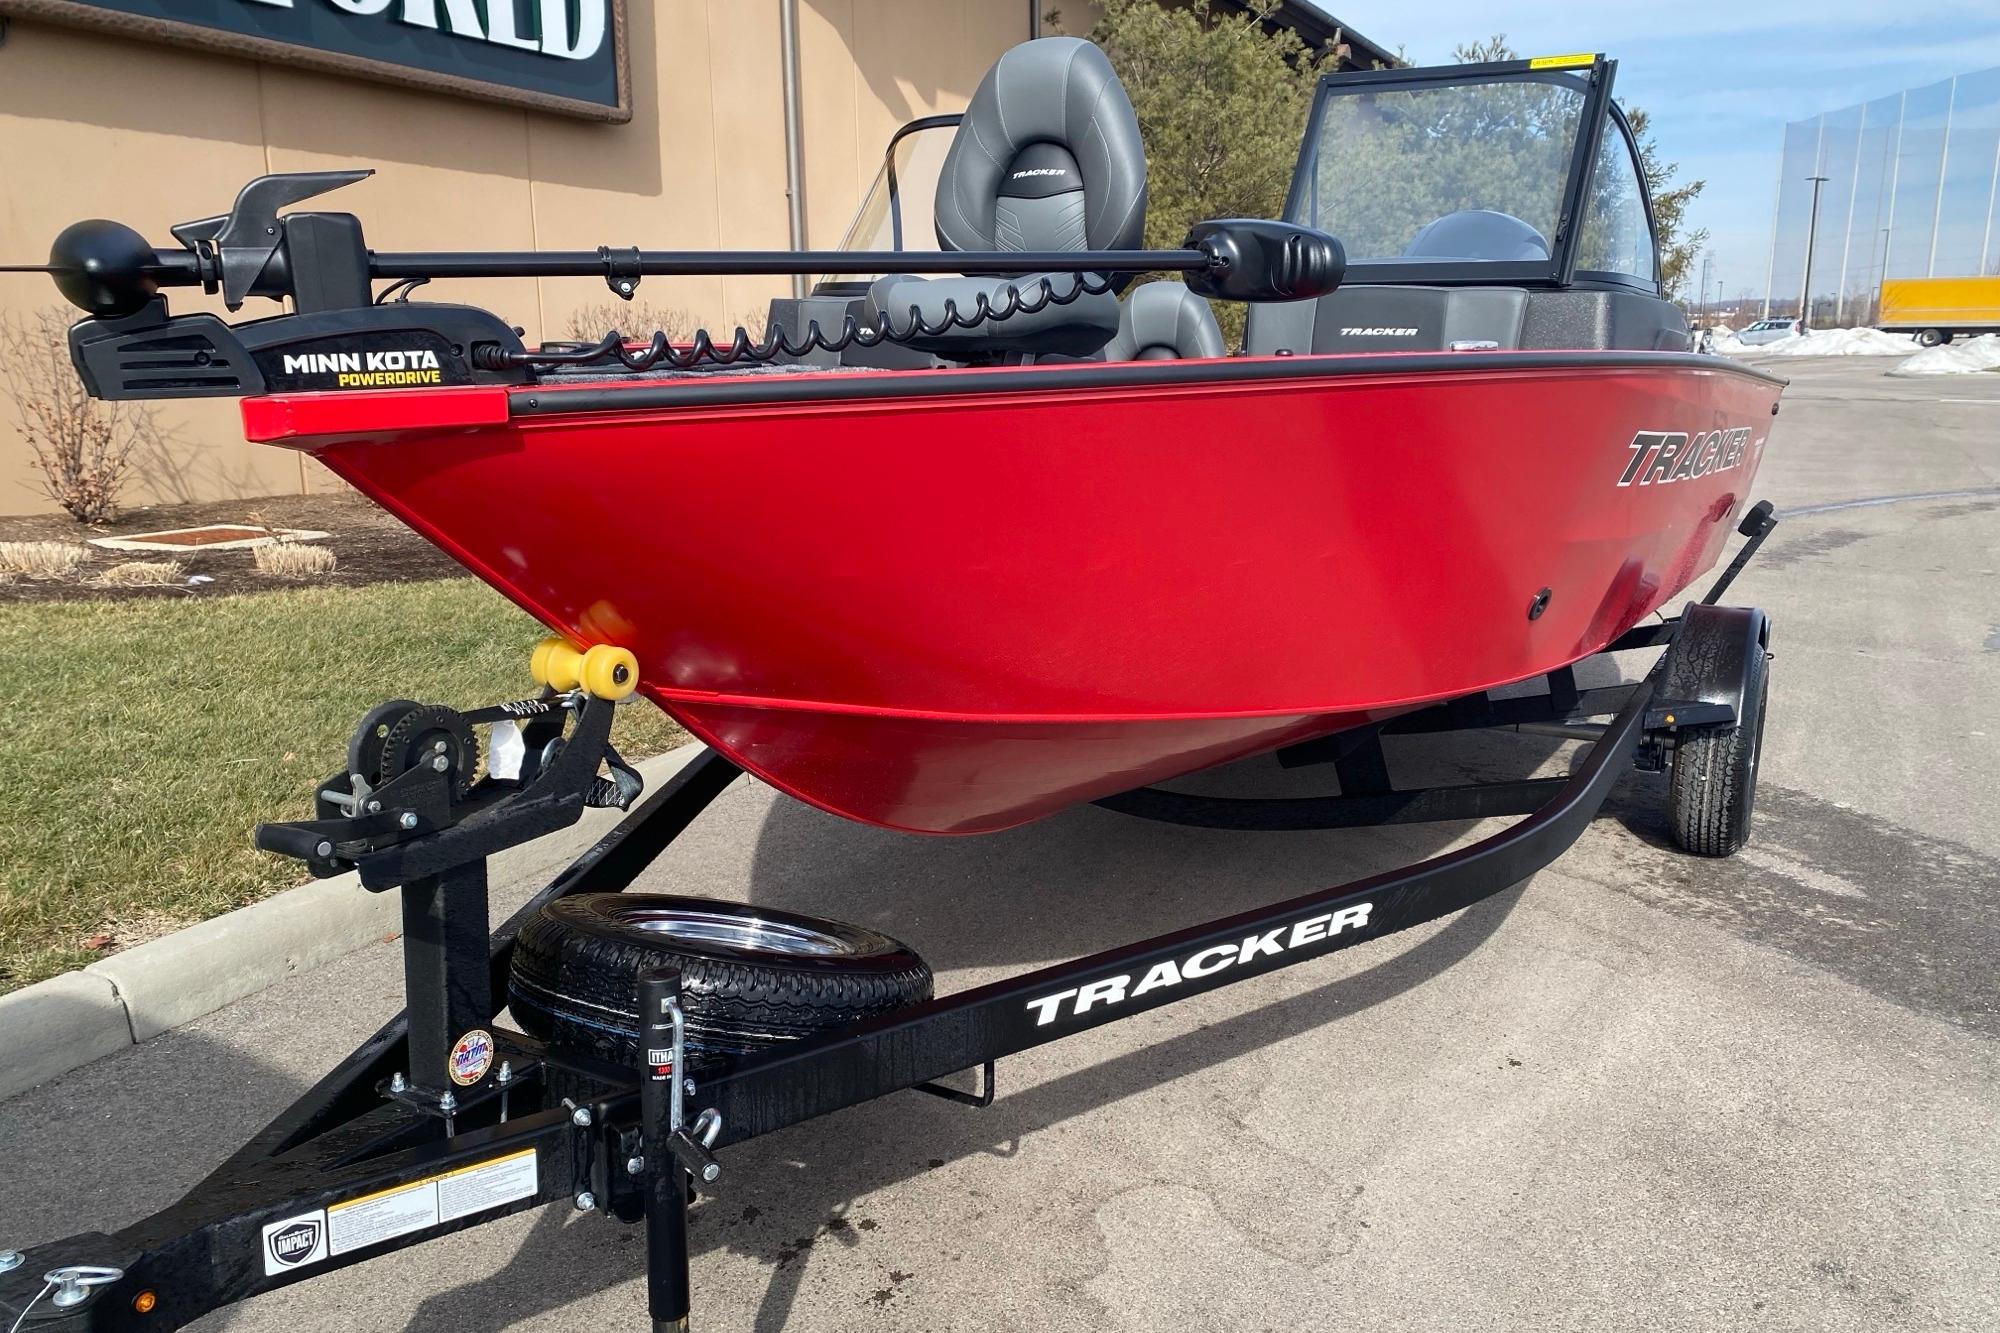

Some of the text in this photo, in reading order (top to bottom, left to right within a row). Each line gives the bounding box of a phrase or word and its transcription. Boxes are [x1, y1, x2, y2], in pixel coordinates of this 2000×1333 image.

[1012, 168, 1066, 179] TRACKER
[1340, 327, 1418, 336] TRACKER
[283, 350, 440, 374] MINN KOTA
[338, 370, 441, 387] POWERDRIVE
[1616, 426, 1752, 487] TRACKER
[1026, 902, 1374, 1016] TRACKER
[651, 1050, 673, 1063] ITHA
[277, 1230, 314, 1255] IMPACT
